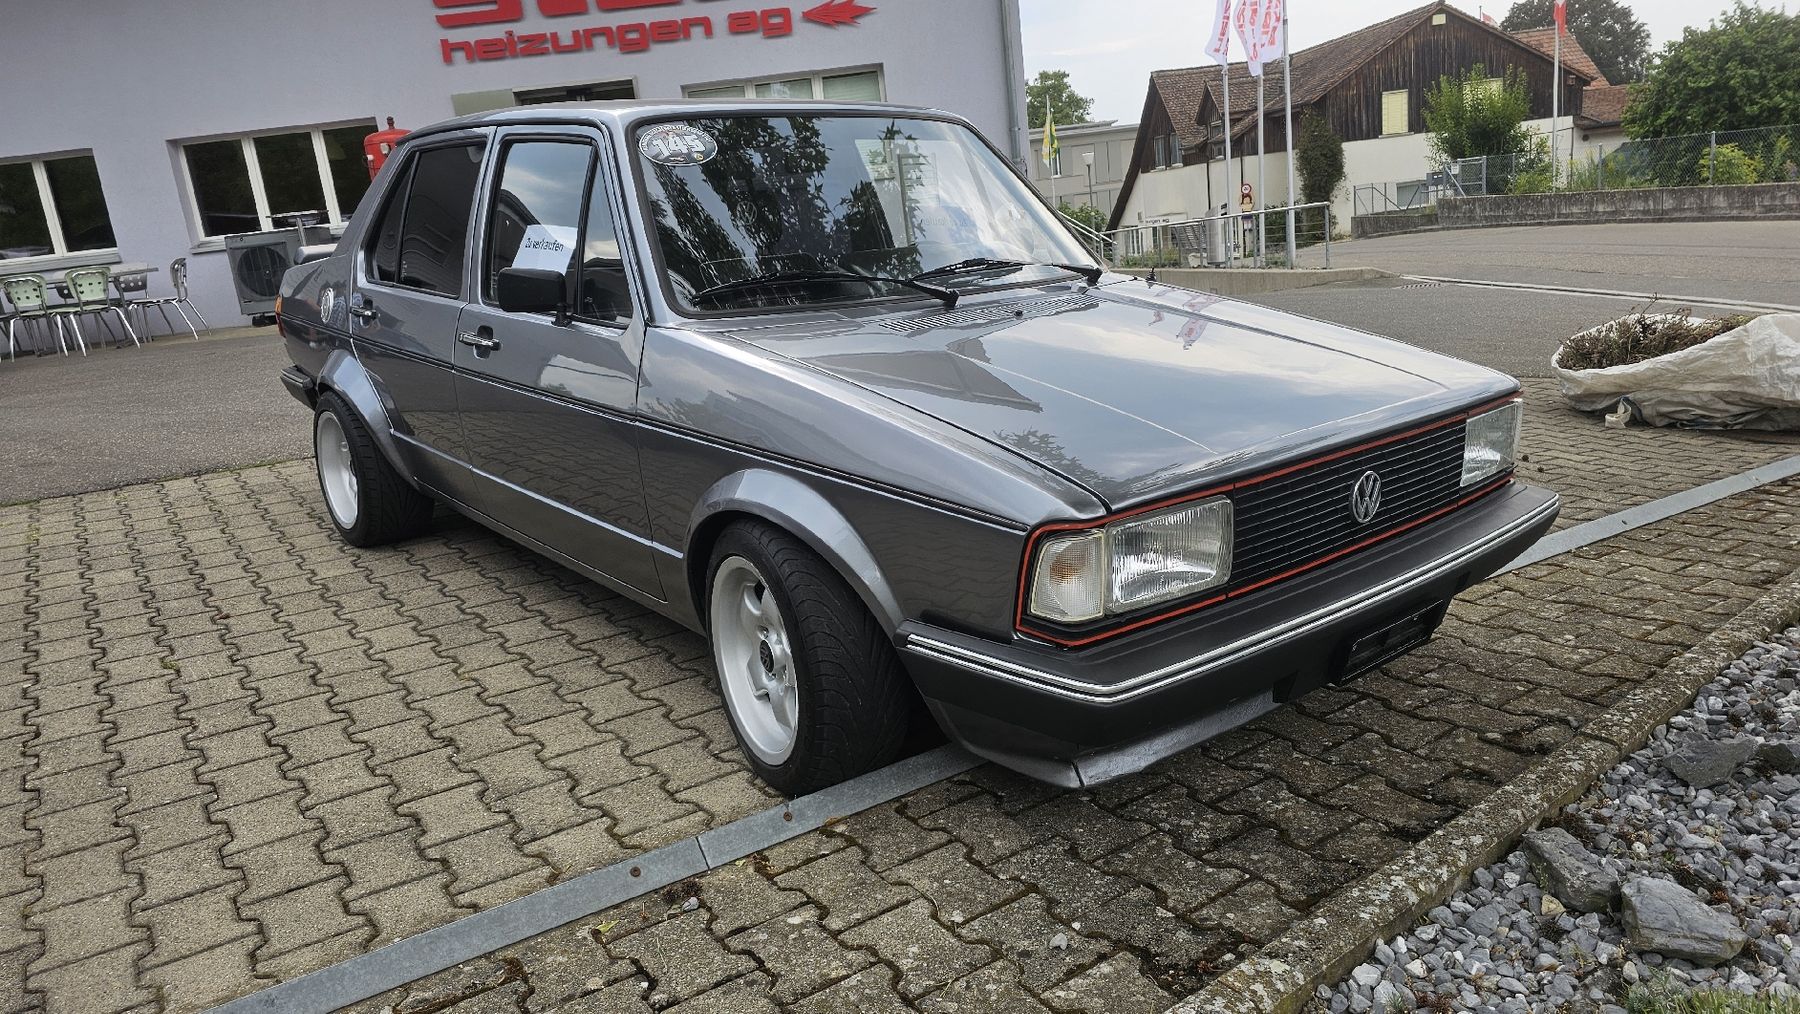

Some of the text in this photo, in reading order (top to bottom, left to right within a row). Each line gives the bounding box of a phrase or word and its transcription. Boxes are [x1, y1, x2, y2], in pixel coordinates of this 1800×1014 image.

[440, 16, 713, 65] heizungen
[727, 7, 793, 38] ag
[652, 134, 706, 159] 145
[533, 237, 564, 252] verkaufen
[1353, 471, 1381, 523] VW
